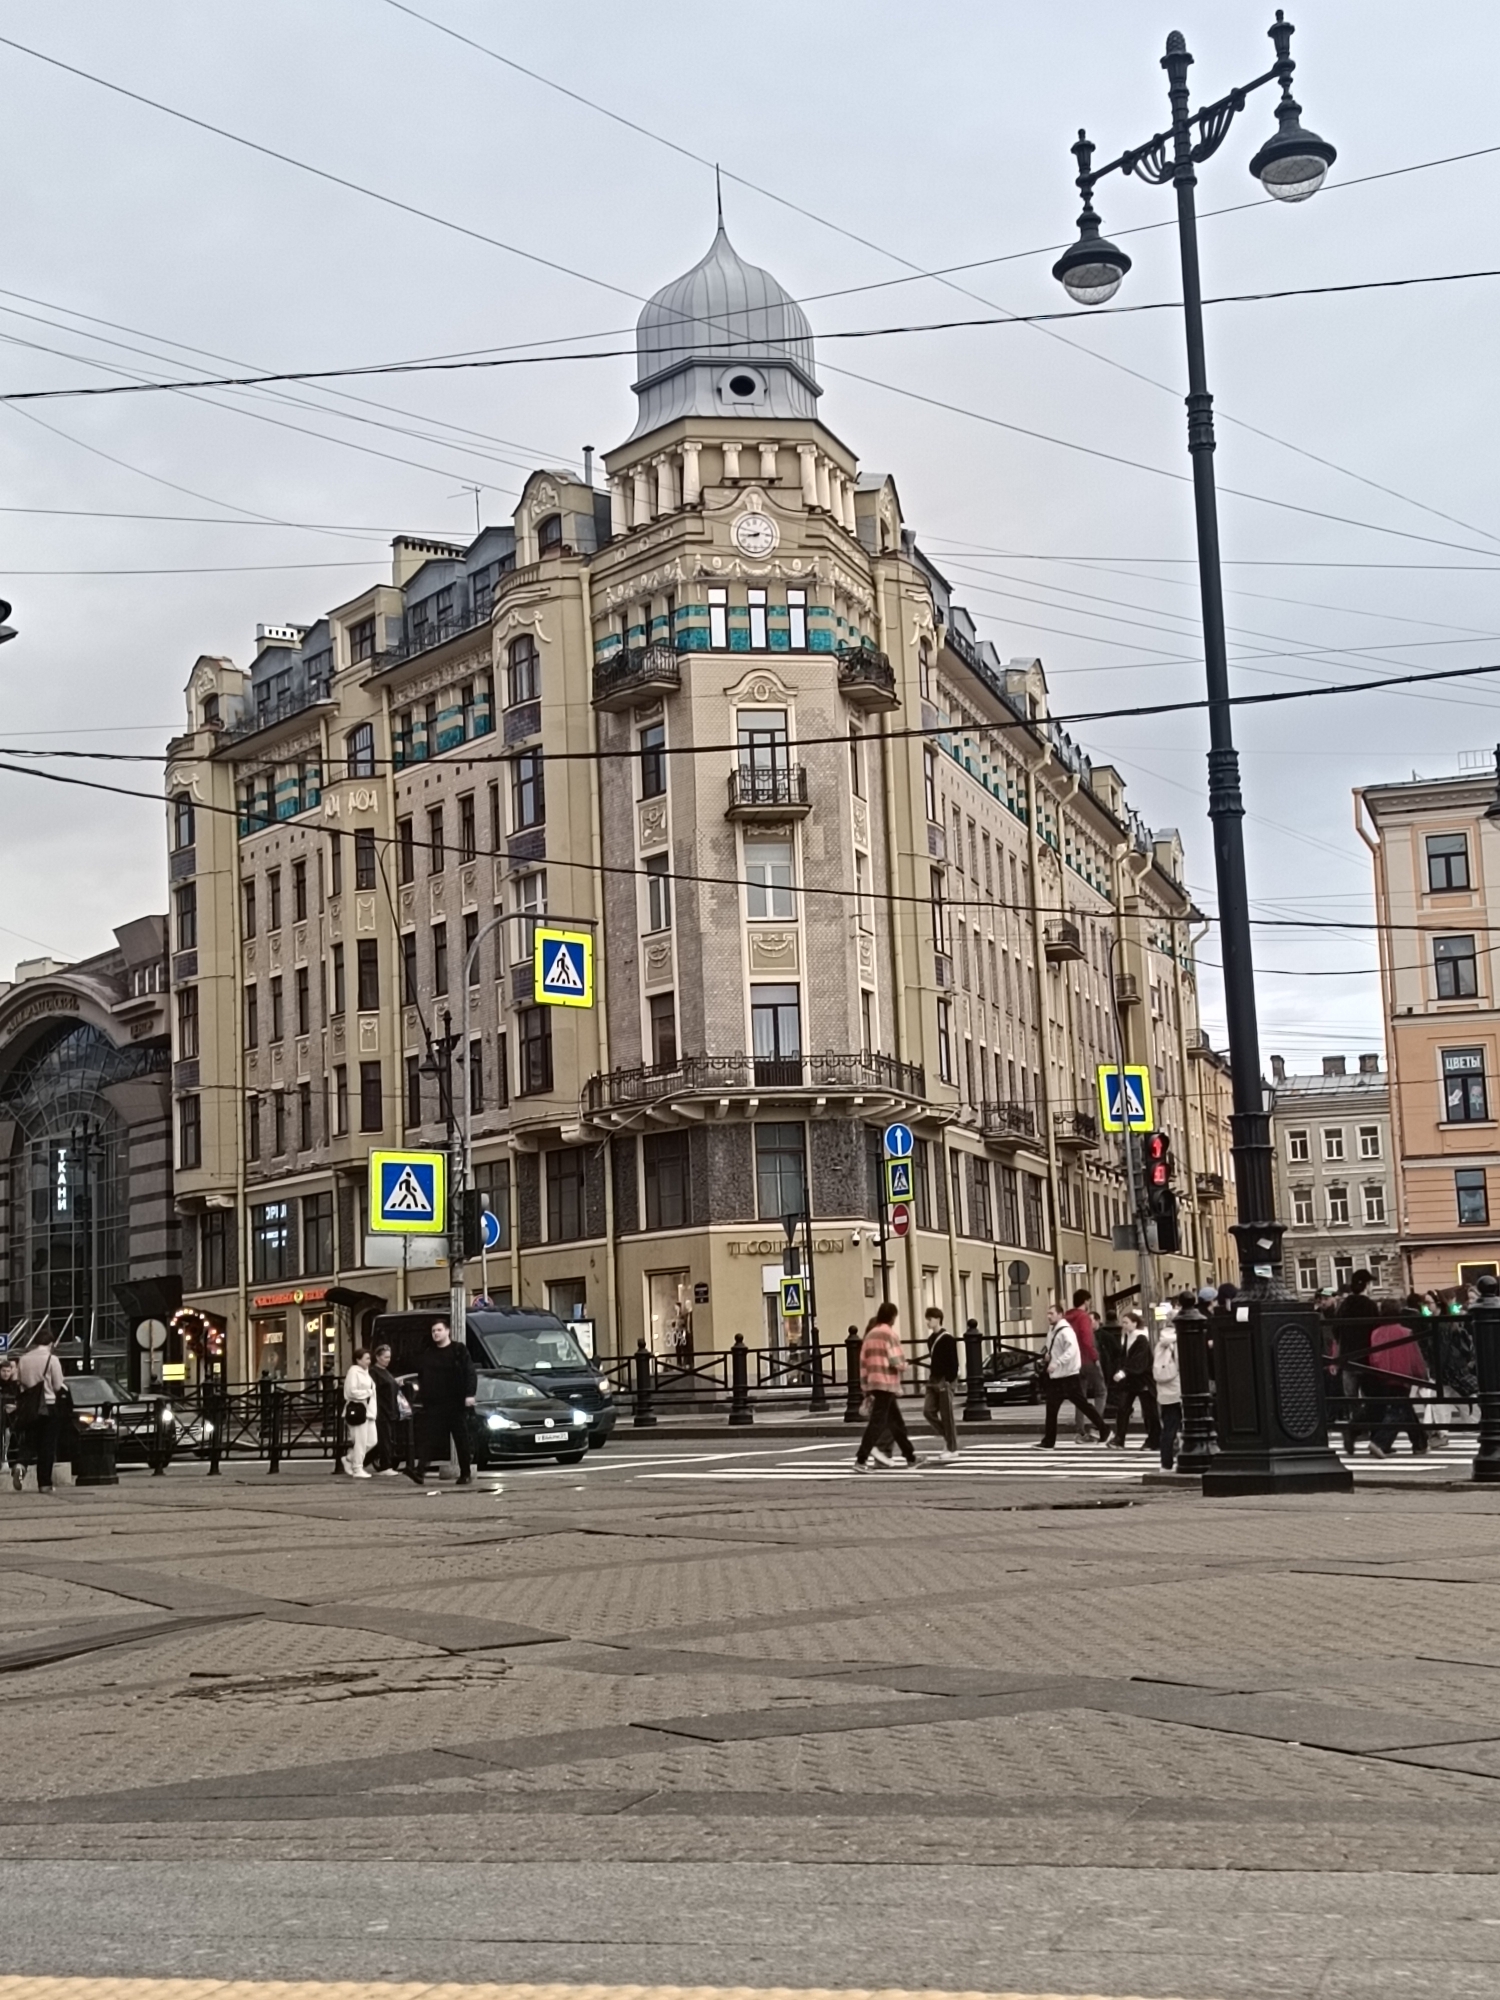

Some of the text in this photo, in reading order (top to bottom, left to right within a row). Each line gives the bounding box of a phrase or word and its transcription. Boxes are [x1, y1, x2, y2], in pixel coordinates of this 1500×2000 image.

[1445, 1055, 1481, 1070] ЦВЕТЫ
[57, 1149, 67, 1211] ТКАНИ
[665, 1329, 687, 1347] 30%
